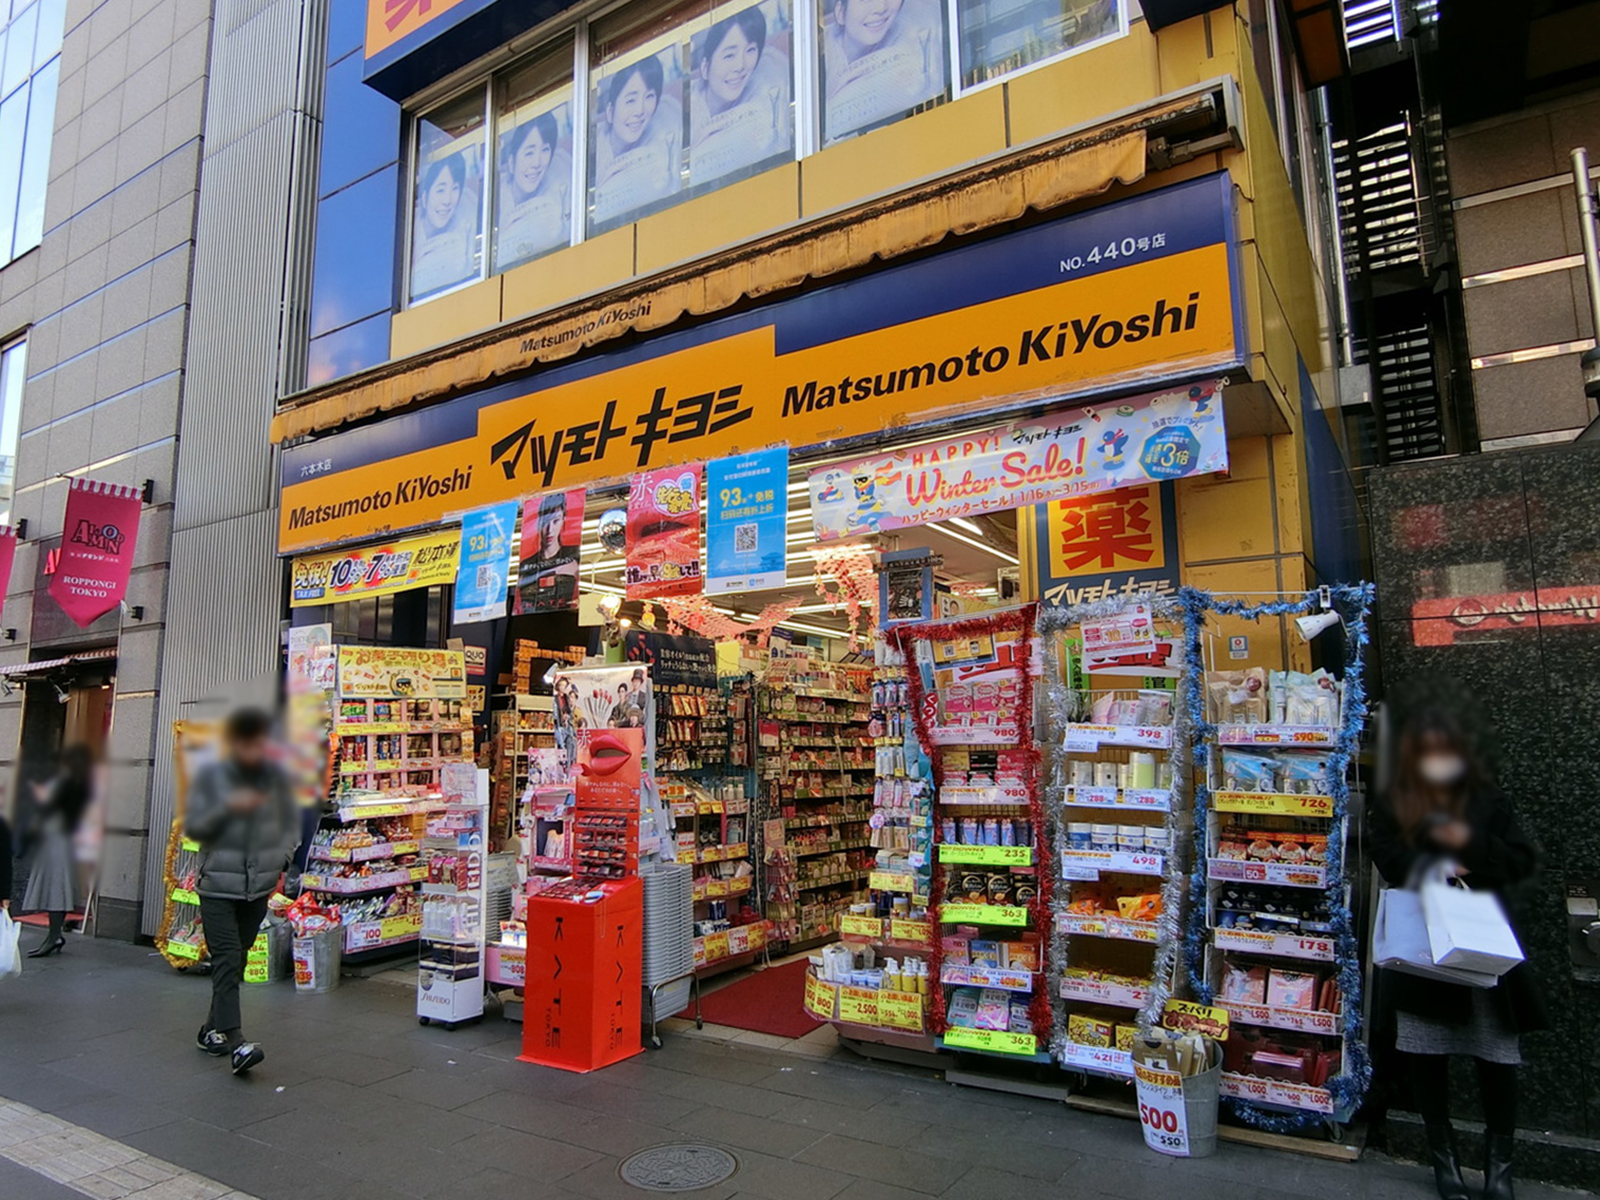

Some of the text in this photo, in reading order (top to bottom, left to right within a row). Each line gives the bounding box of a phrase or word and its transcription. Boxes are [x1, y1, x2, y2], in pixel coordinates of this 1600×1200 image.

[519, 301, 652, 355] Matsumoto KiYoshi
[781, 292, 1200, 418] Matsumoto KiYoshi
[490, 384, 754, 487] マツモトキヨシ
[911, 436, 1000, 469] HAPPY!
[300, 458, 332, 478] 六本木店
[905, 436, 1086, 507] Winter Sale!
[629, 472, 654, 503] 赤
[288, 465, 474, 530] Matsumoto KiYoshi
[1059, 486, 1155, 571] 薬
[62, 575, 117, 590] ROPPONGI
[70, 586, 107, 598] TOKYO
[465, 650, 486, 661] QUO
[994, 728, 1016, 736] 980
[1137, 728, 1162, 739] 398
[1294, 732, 1314, 742] 590
[1004, 788, 1026, 797] 980
[1300, 798, 1327, 808] 726
[1004, 849, 1026, 858] 235
[1132, 855, 1157, 866] 498
[1246, 870, 1259, 879] 50
[1001, 908, 1023, 918] 363
[365, 928, 382, 939] 100
[1300, 940, 1329, 951] 178
[552, 916, 564, 1049] KATE
[615, 924, 625, 1048] KATE
[420, 991, 451, 1006] SHISEIDO
[857, 1002, 878, 1015] 2,500
[1011, 1036, 1032, 1045] 363
[1140, 1102, 1178, 1133] 500
[1160, 1135, 1181, 1146] 550
